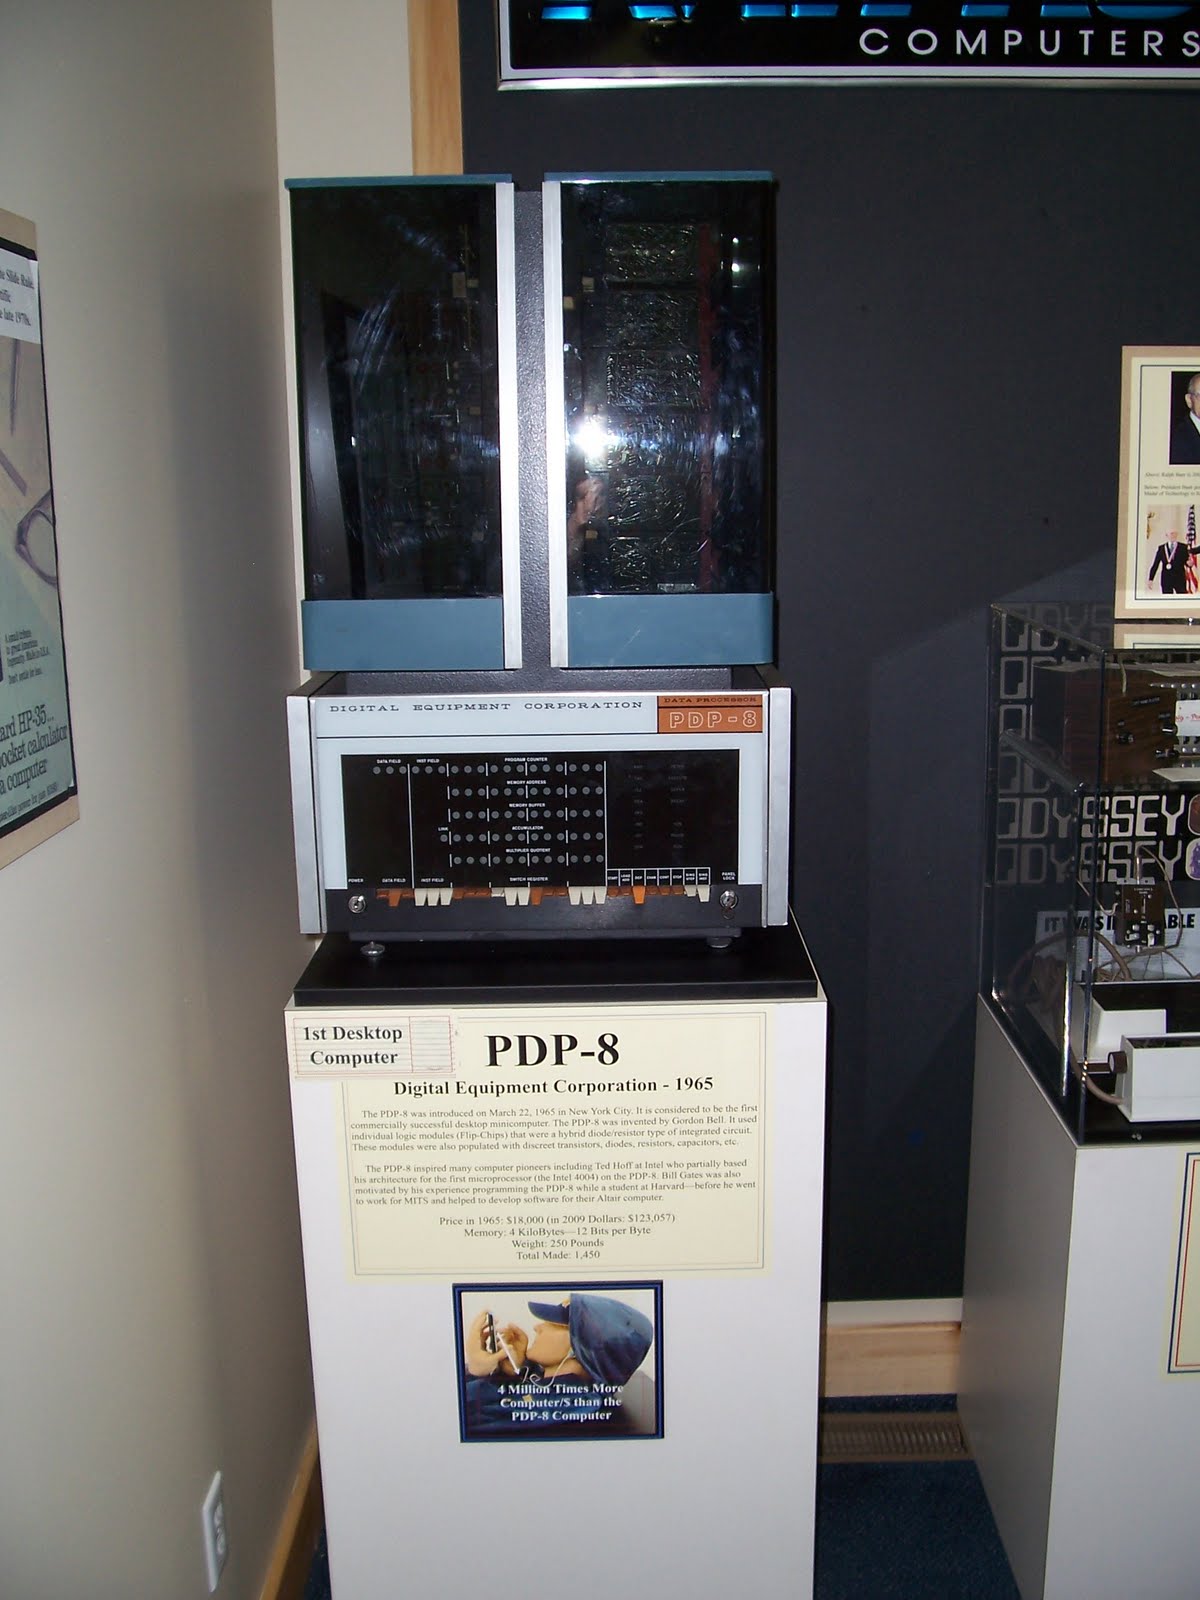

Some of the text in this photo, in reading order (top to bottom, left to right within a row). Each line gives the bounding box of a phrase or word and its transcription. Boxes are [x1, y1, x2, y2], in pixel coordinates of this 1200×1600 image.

[859, 28, 1200, 57] COMPUTERS
[329, 701, 643, 712] DIGITAL EQUIPMENT CORPORATION
[696, 695, 757, 703] PROCESSOR
[669, 710, 757, 728] PDP-8
[0, 725, 67, 770] ocket calculator
[8, 758, 48, 789] computer
[304, 1026, 403, 1043] 1st Desktop
[485, 1032, 620, 1067] PDP-8
[310, 1050, 398, 1068] Computer
[394, 1081, 450, 1098] Digital
[455, 1080, 548, 1097] Equipment
[553, 1079, 657, 1095] Corporation
[675, 1076, 714, 1091] 1965
[362, 1110, 378, 1118] The
[379, 1109, 408, 1118] PDP-8
[428, 1108, 474, 1117] introduced
[488, 1108, 517, 1116] March
[518, 1108, 532, 1117] 22,
[535, 1107, 556, 1116] 1965
[557, 1107, 567, 1115] in
[568, 1107, 589, 1115] New
[590, 1107, 612, 1115] York
[612, 1106, 634, 1117] City.
[636, 1106, 643, 1114] It
[644, 1106, 653, 1114] is
[653, 1105, 700, 1114] considered
[701, 1104, 711, 1113] to
[712, 1104, 724, 1113] be
[724, 1104, 739, 1113] the
[740, 1104, 758, 1113] first
[350, 1120, 408, 1131] commercially
[409, 1120, 453, 1128] successful
[454, 1119, 488, 1130] desktop
[489, 1118, 550, 1129] minicomputer.
[551, 1118, 569, 1126] The
[571, 1117, 600, 1126] PDP-8
[620, 1117, 657, 1125] invented
[658, 1116, 670, 1126] by
[671, 1116, 704, 1124] Gordon
[706, 1114, 726, 1124] Bell.
[728, 1114, 736, 1123] It
[737, 1114, 757, 1123] used
[352, 1131, 394, 1140] individual
[395, 1131, 417, 1141] logic
[418, 1130, 455, 1139] modules
[455, 1130, 509, 1140] (Flip-Chips)
[509, 1129, 526, 1138] that
[557, 1129, 586, 1139] hybrid
[587, 1128, 646, 1136] diode/resistor
[646, 1127, 666, 1138] type
[666, 1127, 678, 1135] of
[678, 1126, 721, 1137] integrated
[365, 1159, 747, 1174] The PDP-8 inspired many computer pioneers including Ted Hoff at Intel who partially based
[356, 1197, 364, 1205] to
[365, 1197, 388, 1205] work
[389, 1196, 402, 1205] for
[404, 1196, 429, 1204] MITS
[430, 1196, 446, 1204] and
[447, 1196, 476, 1206] helped
[477, 1195, 487, 1204] to
[488, 1195, 522, 1205] develop
[522, 1195, 560, 1203] software
[561, 1194, 574, 1203] for
[575, 1194, 596, 1202] their
[596, 1194, 622, 1202] Altair
[439, 1213, 676, 1226] Price in 1965: $18,000 (in 2009 Dollars: $123,057)
[464, 1228, 507, 1239] Memory:
[508, 1228, 515, 1236] 4
[590, 1226, 609, 1234] Bits
[611, 1228, 627, 1236] per
[629, 1225, 652, 1236] Byte
[512, 1239, 605, 1250] Weight: 250 Pounds
[516, 1250, 600, 1260] Total Made: 1,450
[497, 1383, 623, 1394] 4 Million Times More
[500, 1396, 622, 1411] Computer/S than the
[511, 1410, 612, 1423] PDP-8 Computer
